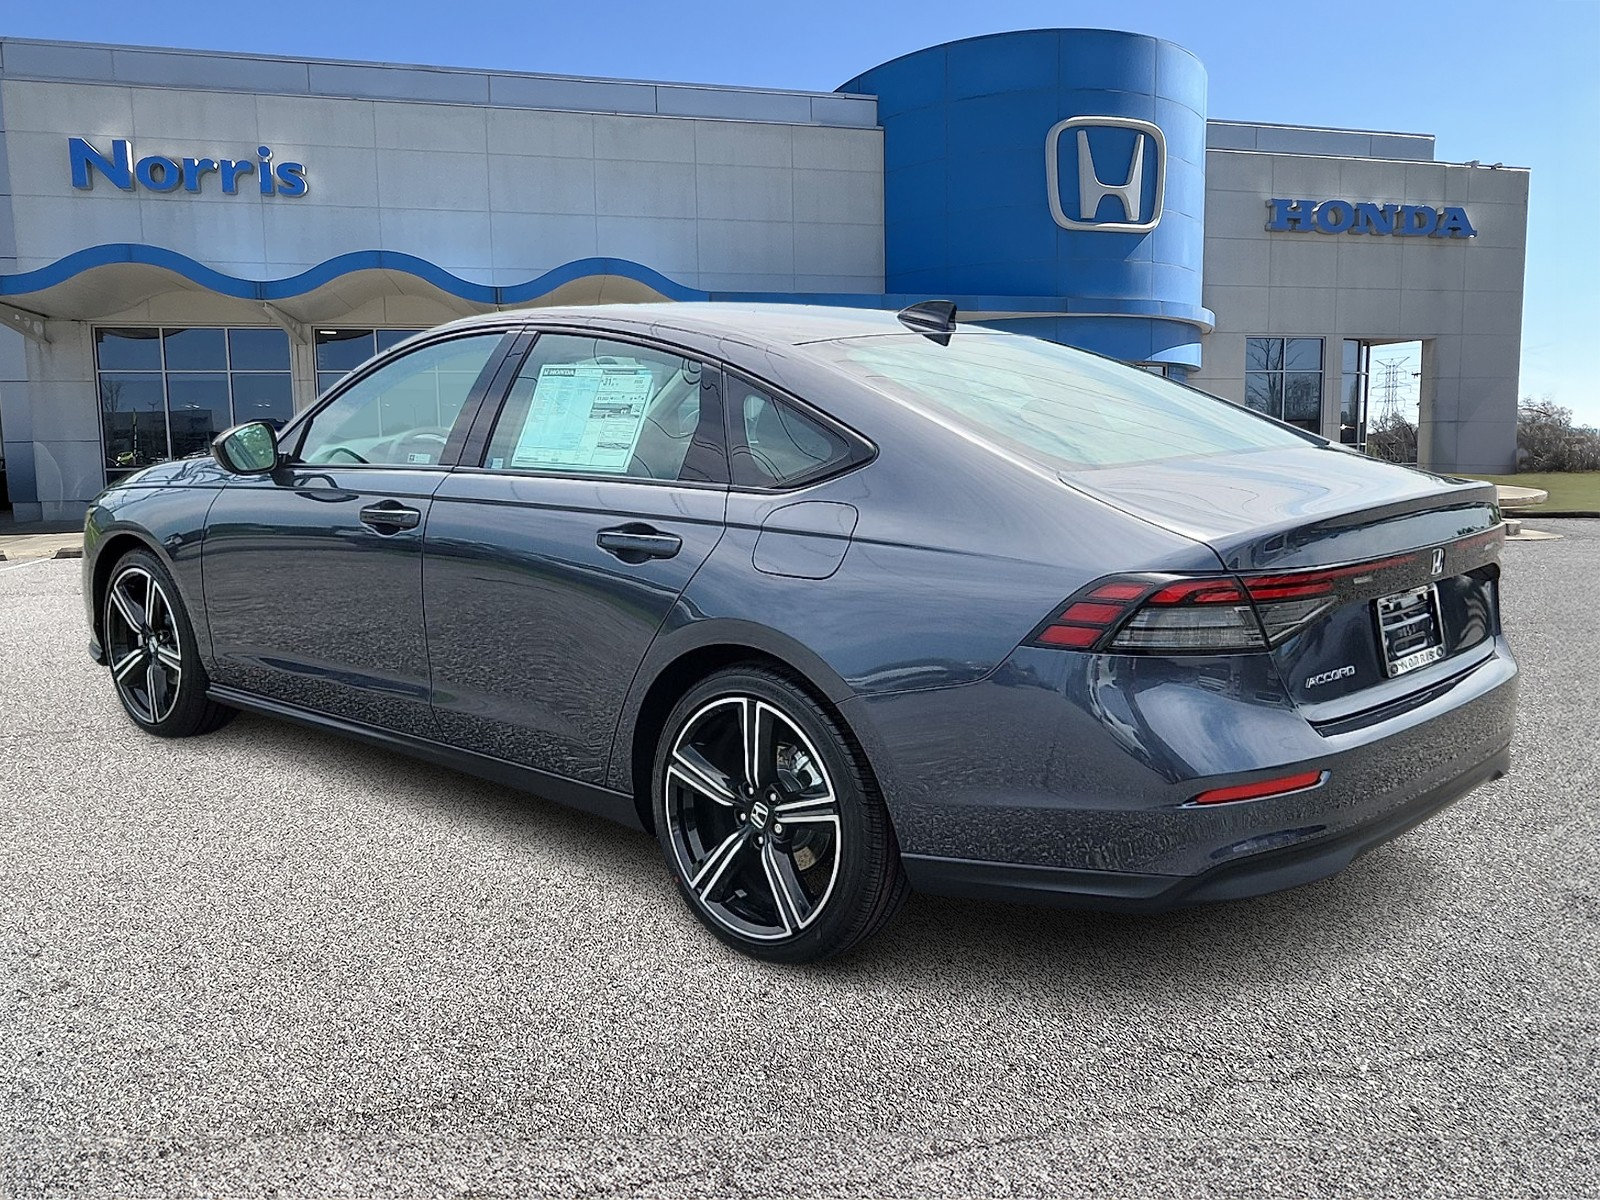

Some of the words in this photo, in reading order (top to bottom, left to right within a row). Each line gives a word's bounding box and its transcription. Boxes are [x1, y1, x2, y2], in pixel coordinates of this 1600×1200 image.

[68, 137, 309, 198] Norris
[1265, 198, 1478, 239] HONDA
[1398, 650, 1436, 670] NORRIS
[1305, 665, 1356, 689] ACCORD
